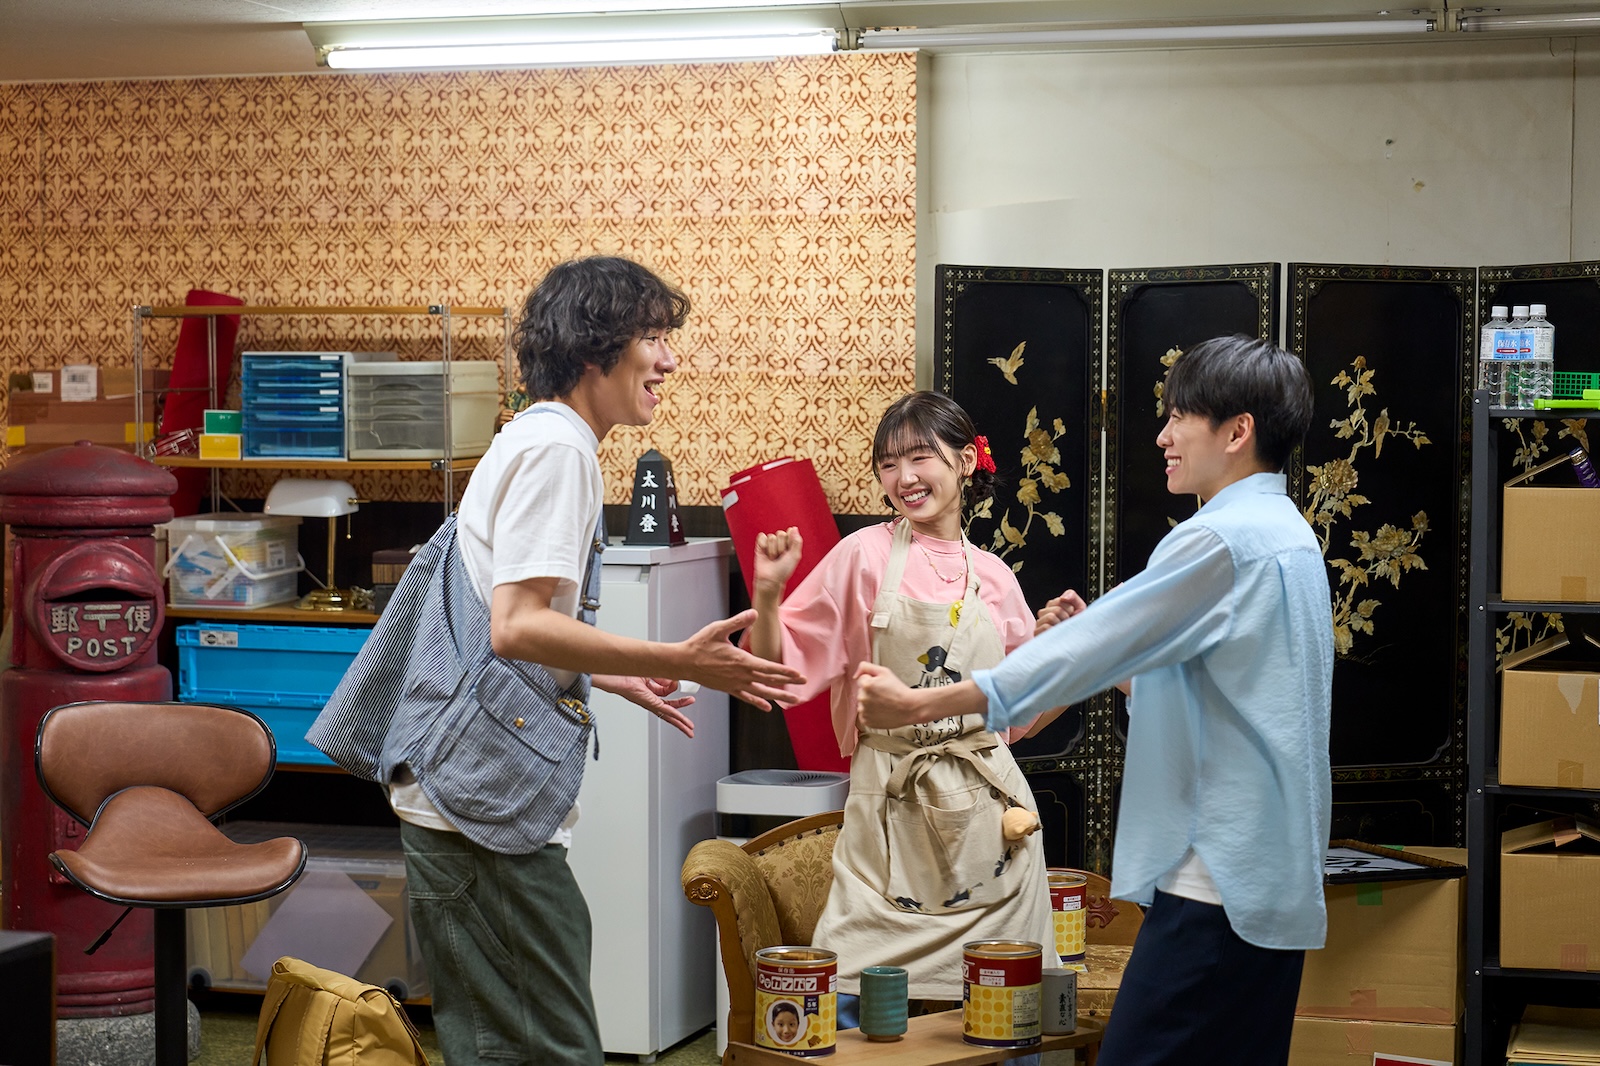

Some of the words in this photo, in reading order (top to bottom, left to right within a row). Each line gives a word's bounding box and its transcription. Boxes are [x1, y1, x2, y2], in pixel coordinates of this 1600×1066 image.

[67, 636, 137, 657] POST
[918, 670, 932, 689] IN
[933, 675, 951, 687] THE
